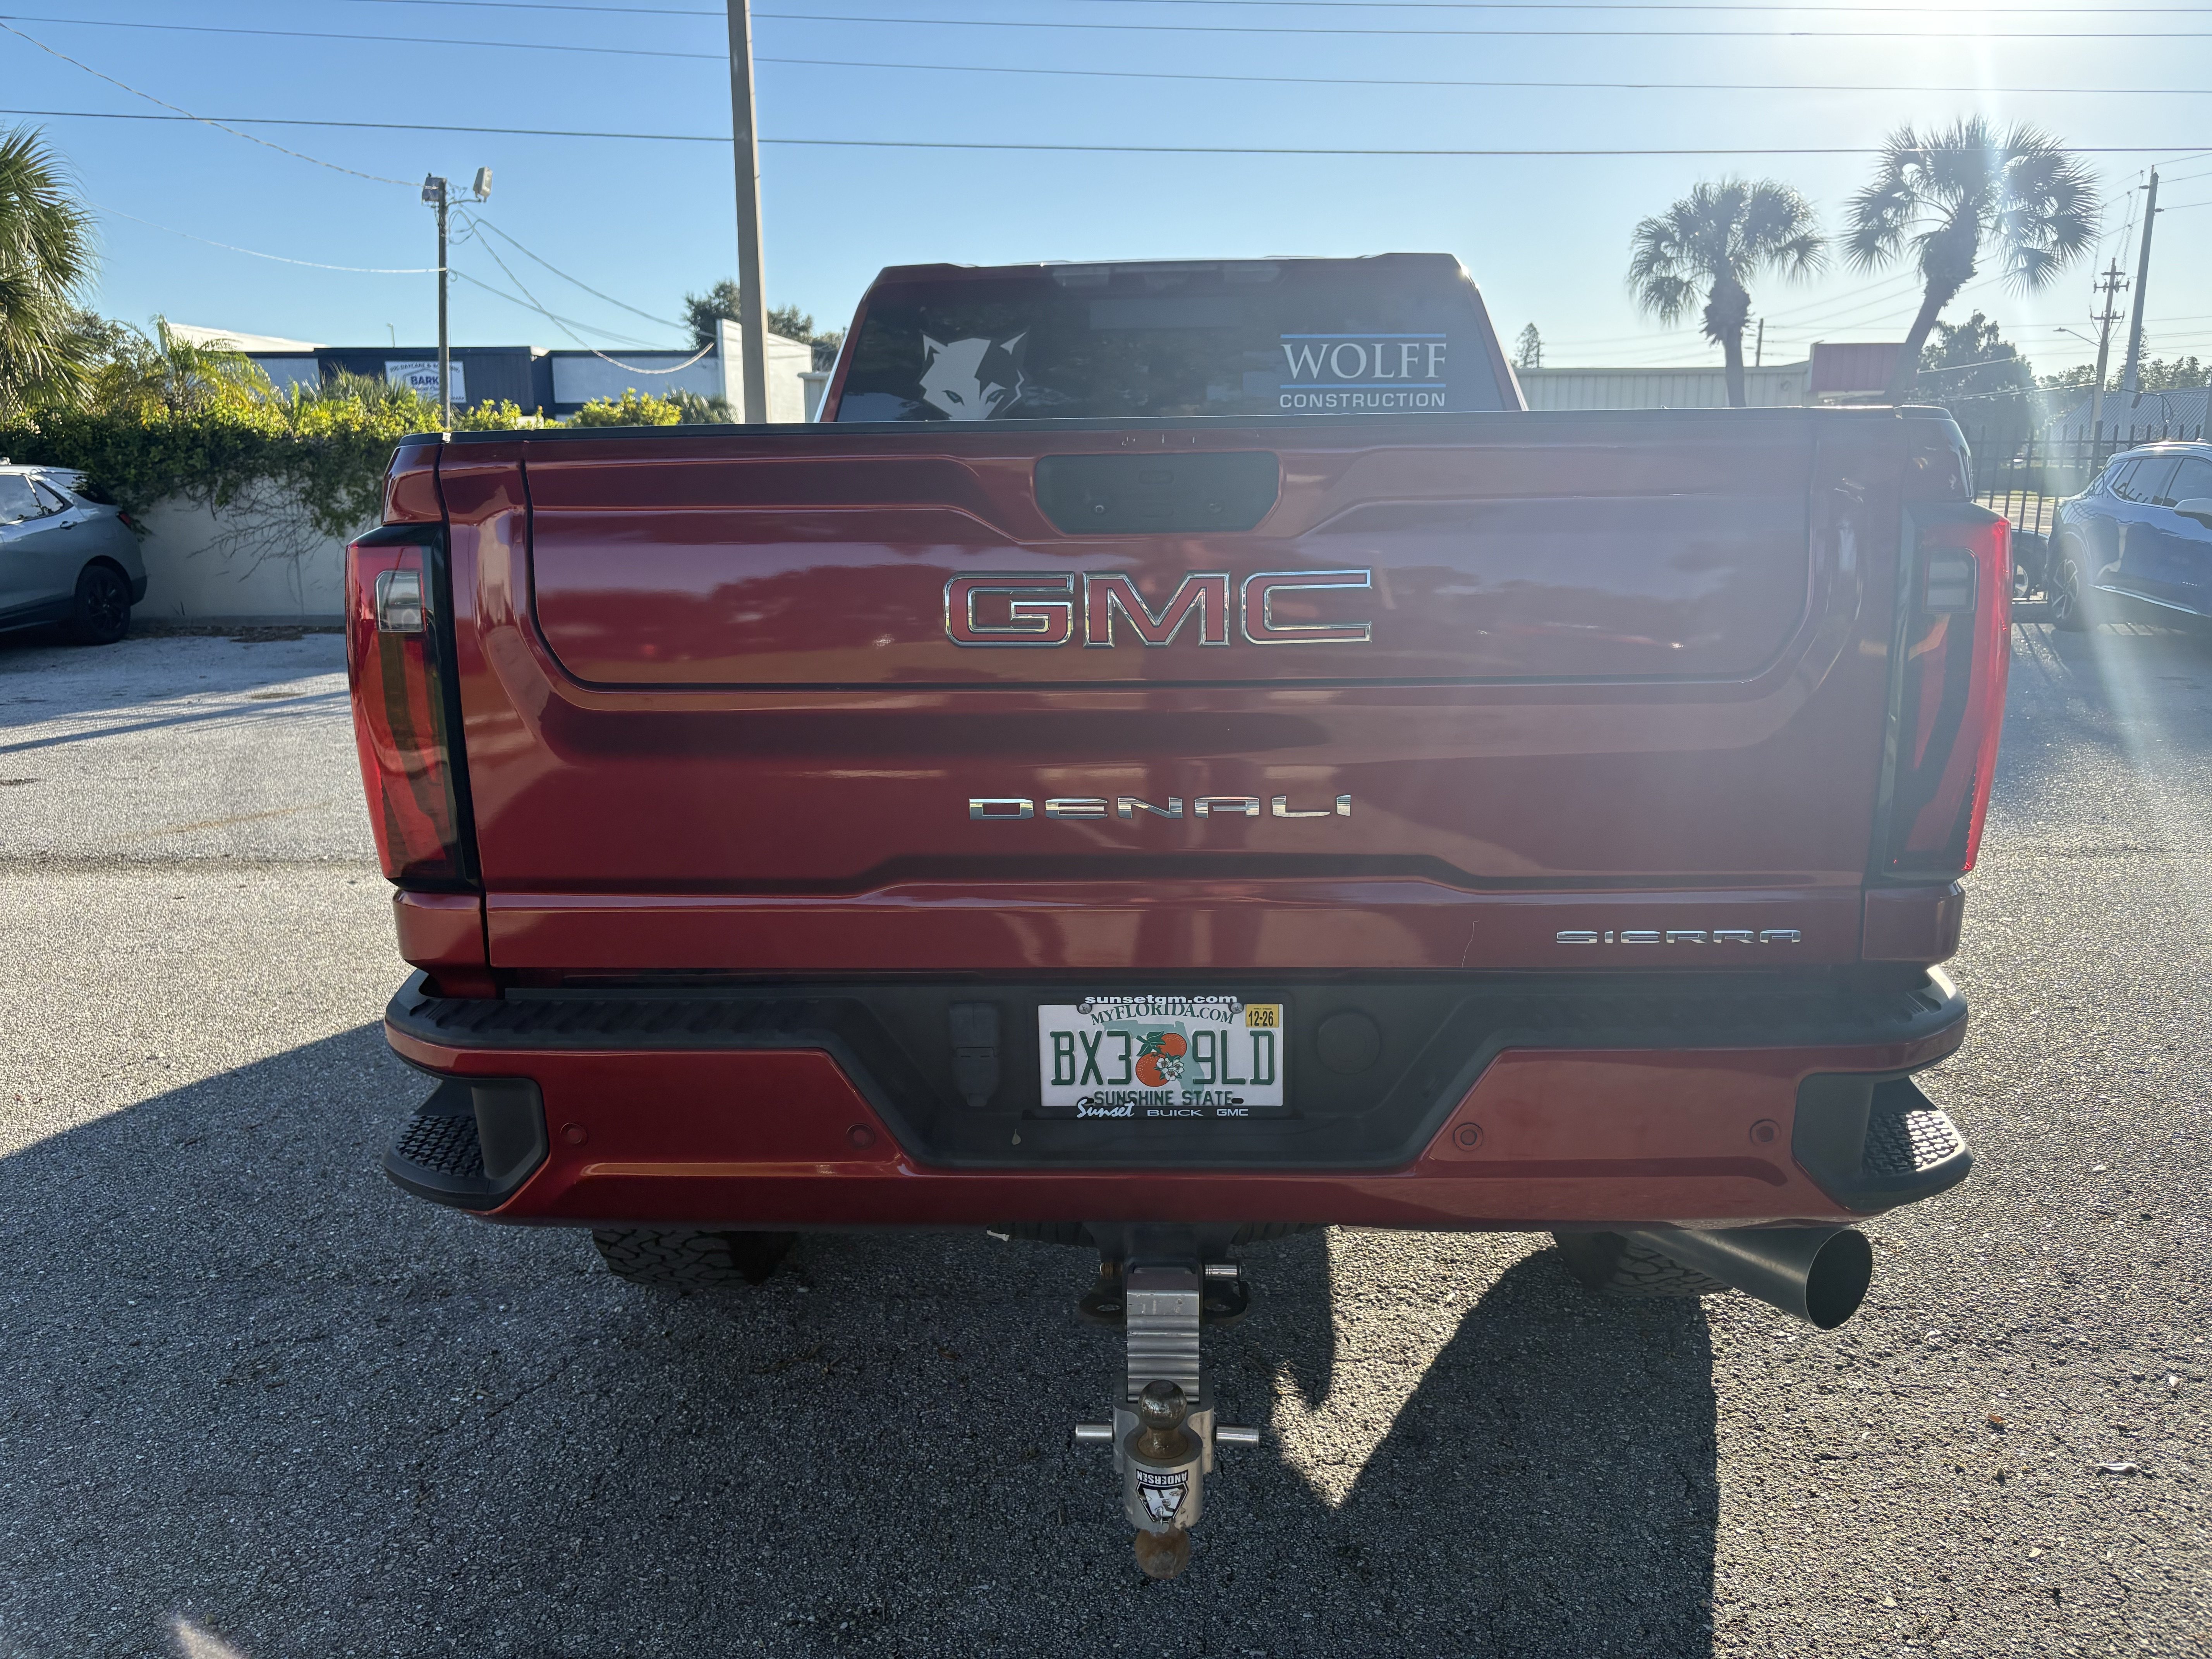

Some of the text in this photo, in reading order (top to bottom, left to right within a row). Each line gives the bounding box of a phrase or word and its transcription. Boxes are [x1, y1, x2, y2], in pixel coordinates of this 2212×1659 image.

[1281, 343, 1447, 379] WOLFF
[411, 376, 439, 385] BARK
[1279, 393, 1446, 408] CONSTRUCTION
[943, 568, 1372, 647] GMC
[969, 794, 1352, 820] DENALI
[1556, 929, 1801, 944] SIERRA
[1085, 994, 1237, 1005] sunsetgm.com
[1090, 1003, 1235, 1025] MYFLORIDA.COM
[1050, 1030, 1275, 1085] BX3 9LD
[1094, 1090, 1233, 1106] SUNSHINE STATE
[1077, 1098, 1135, 1118] Sunset
[1216, 1108, 1249, 1116] GMC
[1137, 1470, 1187, 1485] ANDERSEN
